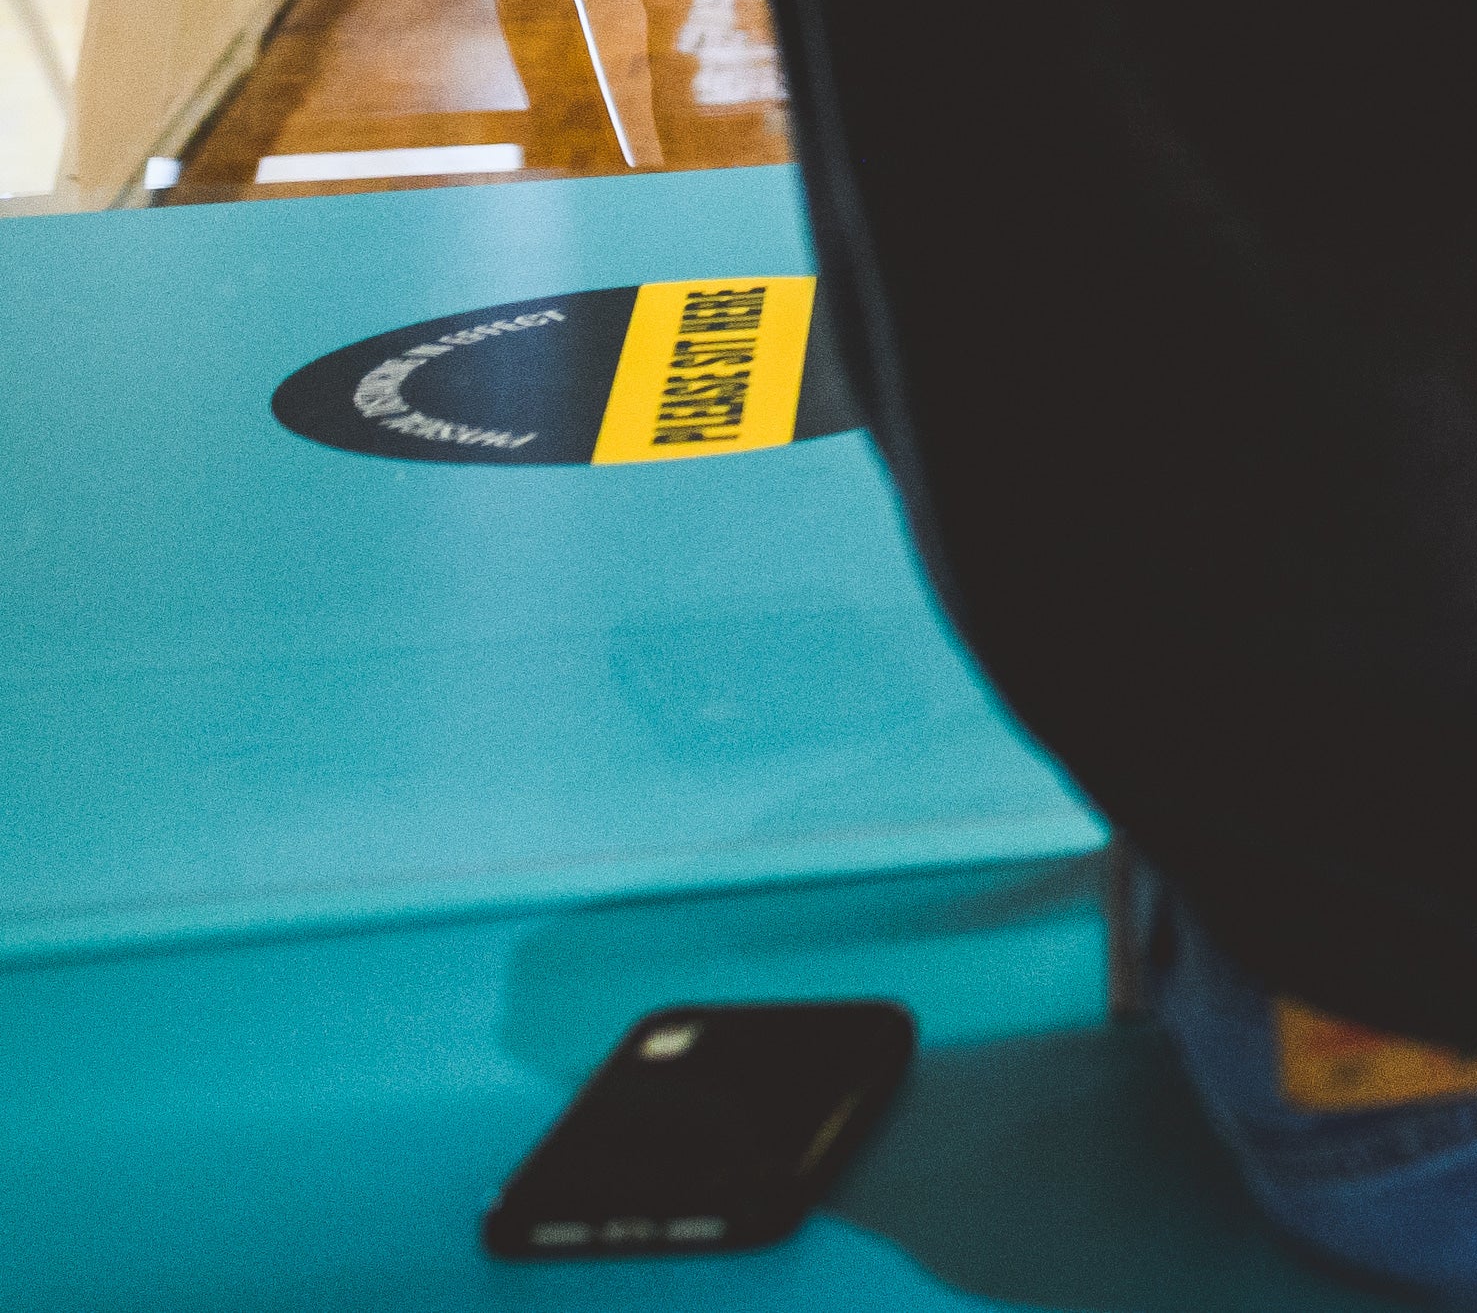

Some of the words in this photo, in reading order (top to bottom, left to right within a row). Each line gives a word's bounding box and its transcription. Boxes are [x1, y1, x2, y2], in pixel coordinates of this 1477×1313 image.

[677, 285, 767, 334] HERE
[668, 337, 757, 369] SIT
[651, 370, 751, 446] PLEASE
